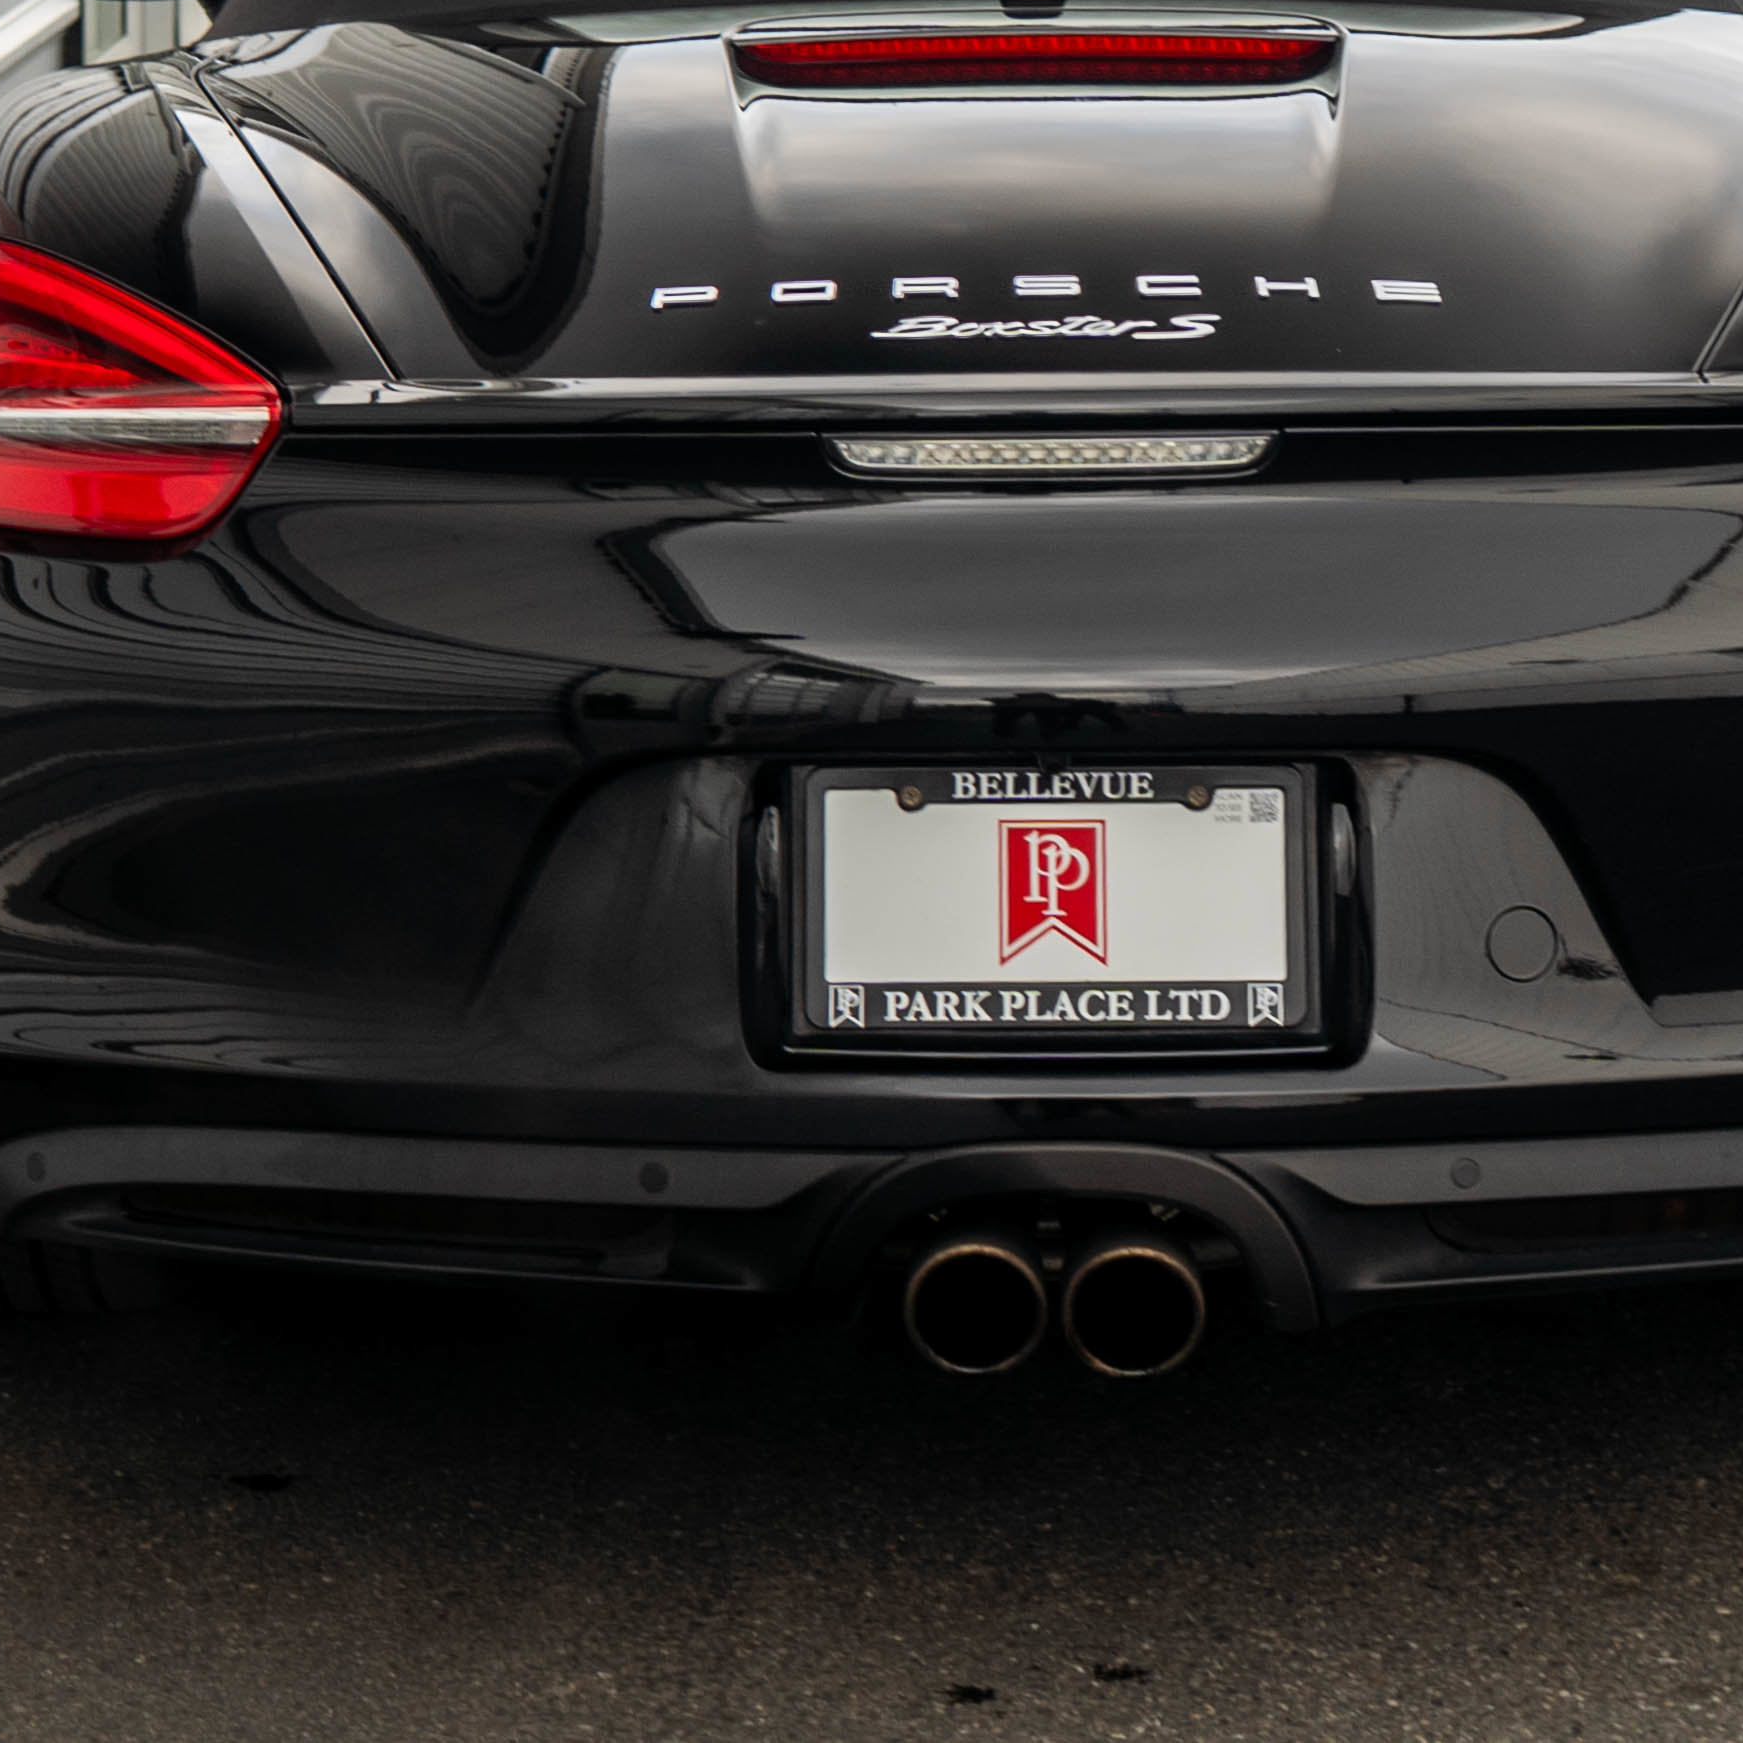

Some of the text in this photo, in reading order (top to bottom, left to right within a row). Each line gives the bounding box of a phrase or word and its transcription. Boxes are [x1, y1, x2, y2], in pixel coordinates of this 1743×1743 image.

[651, 274, 1442, 309] PORSCHE
[870, 313, 1222, 339] Boxster S
[953, 772, 1154, 799] BELLEVUE
[884, 989, 1231, 1022] PARK PLACE LTD
